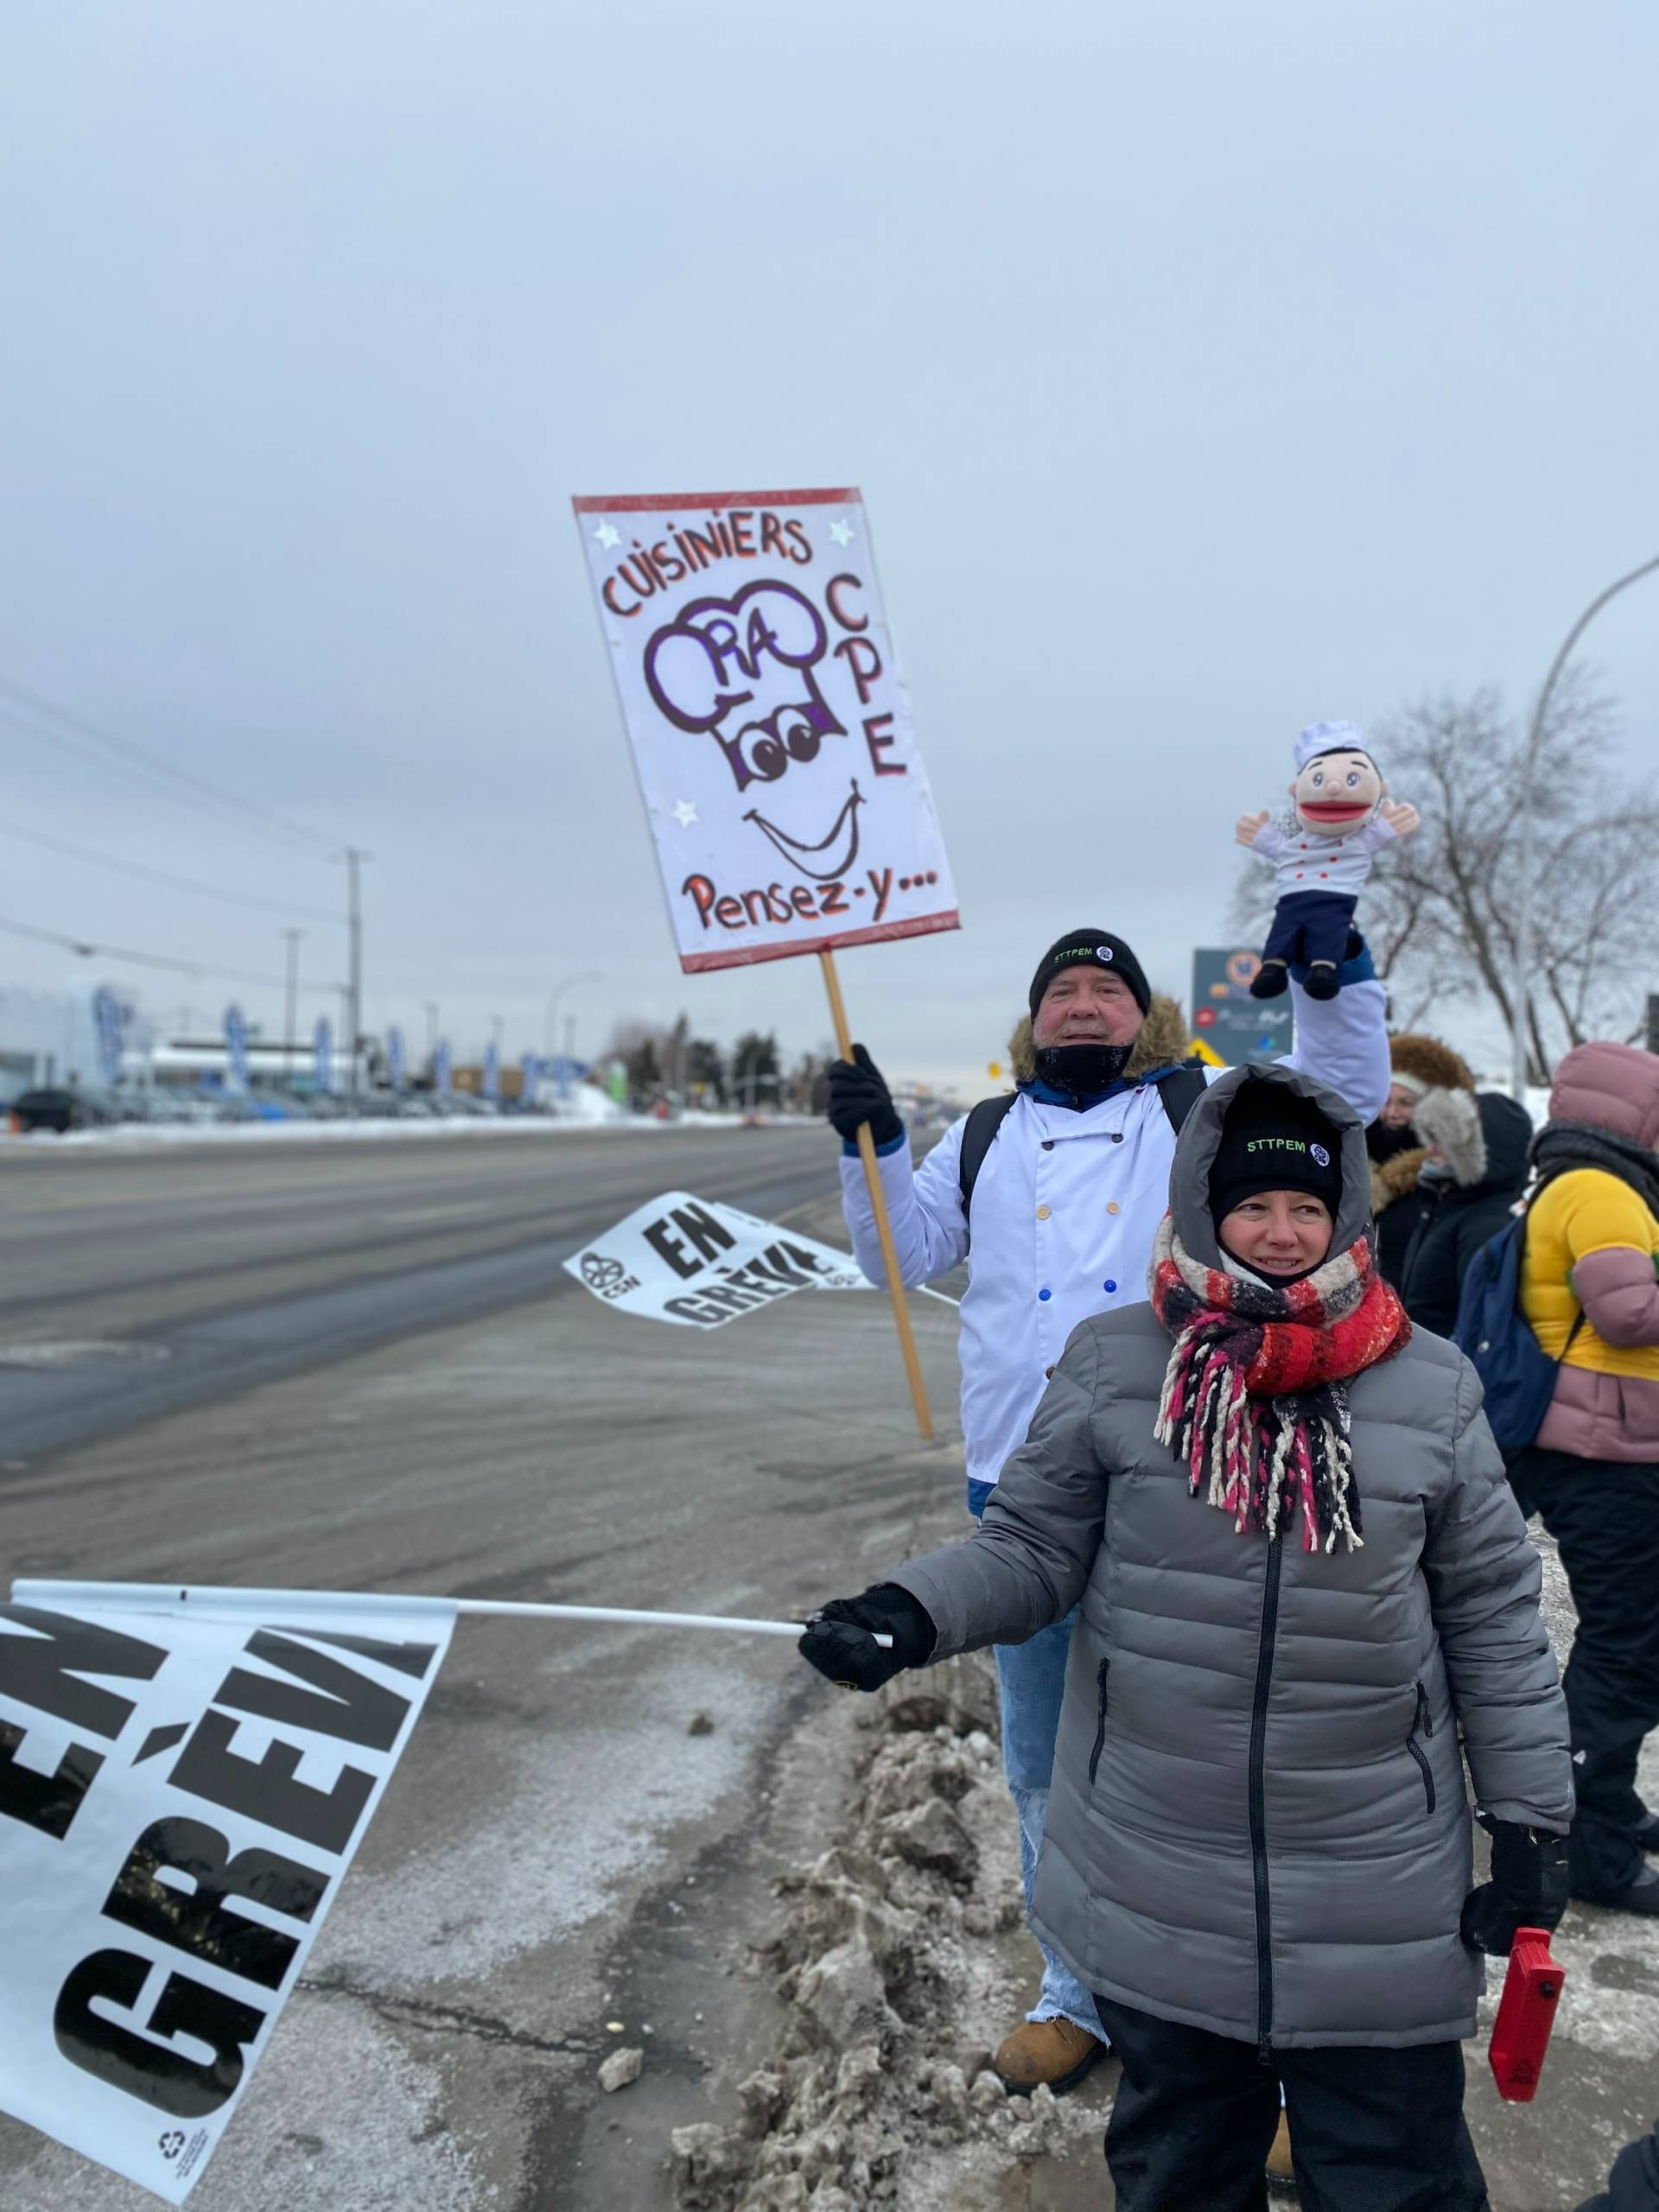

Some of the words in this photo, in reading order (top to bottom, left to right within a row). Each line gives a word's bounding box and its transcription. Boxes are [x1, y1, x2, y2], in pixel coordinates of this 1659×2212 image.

[1054, 947, 1093, 963] STTPEM
[1246, 1138, 1306, 1154] STTPEM
[641, 1201, 738, 1281] EN
[602, 1274, 642, 1300] CSN
